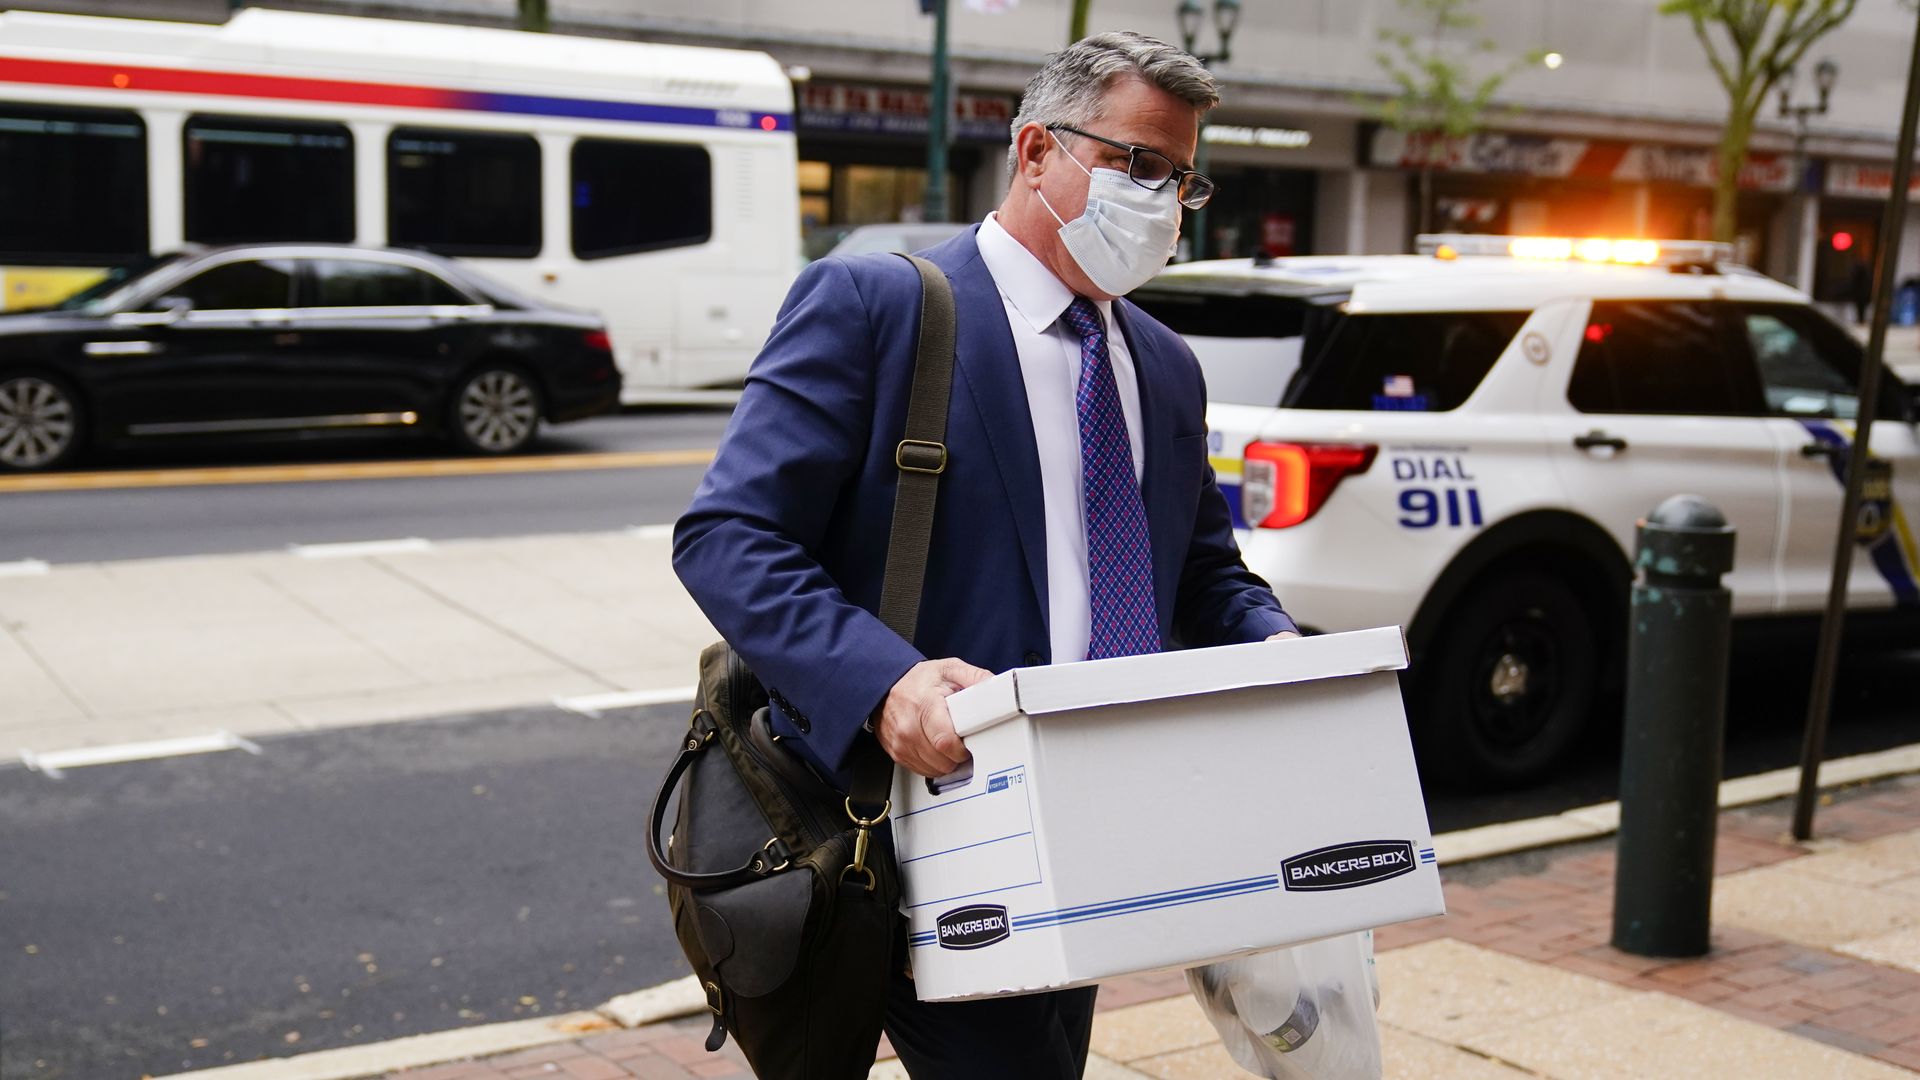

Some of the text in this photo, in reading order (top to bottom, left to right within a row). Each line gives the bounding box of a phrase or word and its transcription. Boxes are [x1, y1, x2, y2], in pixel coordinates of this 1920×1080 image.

[1393, 457, 1474, 480] DIAL
[1398, 488, 1483, 528] 911
[1290, 850, 1408, 880] BANKERS BOX
[941, 915, 1005, 938] BANKERS BOX
